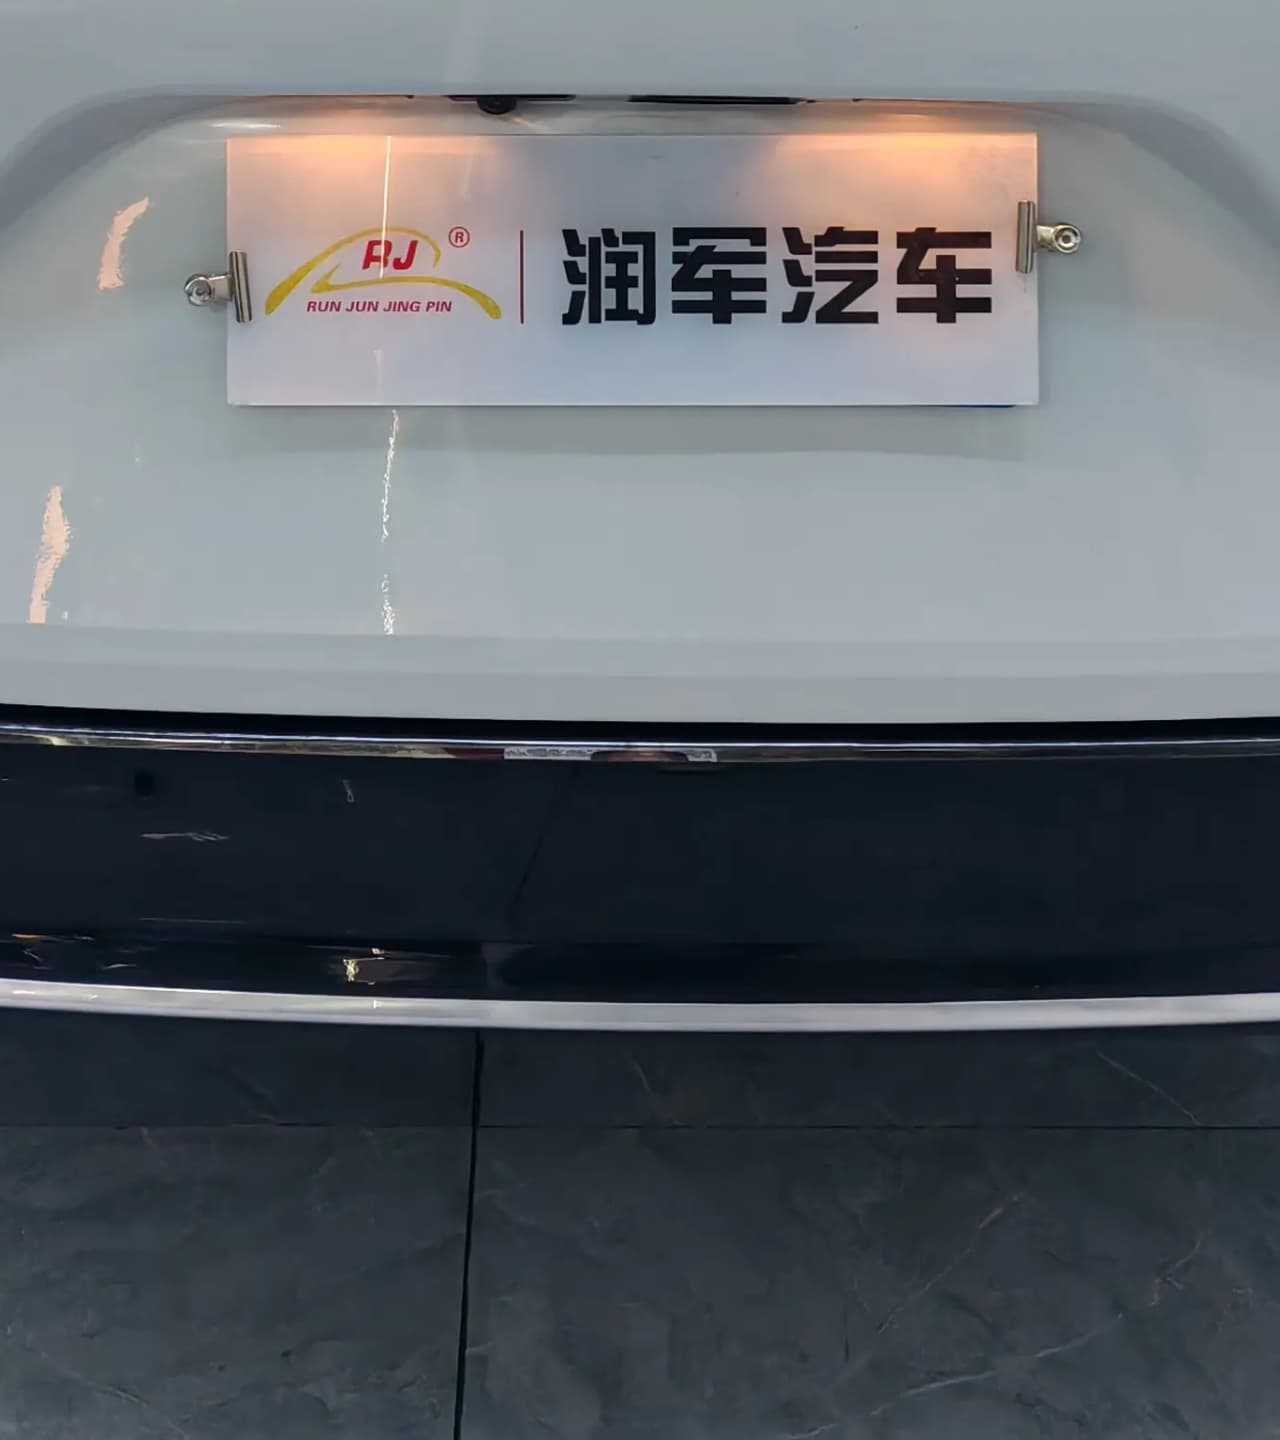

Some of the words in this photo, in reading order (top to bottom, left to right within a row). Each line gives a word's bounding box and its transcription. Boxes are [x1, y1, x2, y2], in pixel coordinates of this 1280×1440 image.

[362, 239, 418, 271] RJ
[561, 227, 994, 326] 润军汽车
[307, 301, 342, 312] RUN
[346, 301, 380, 312] JUN
[383, 301, 421, 312] JING
[425, 301, 452, 312] PIN
